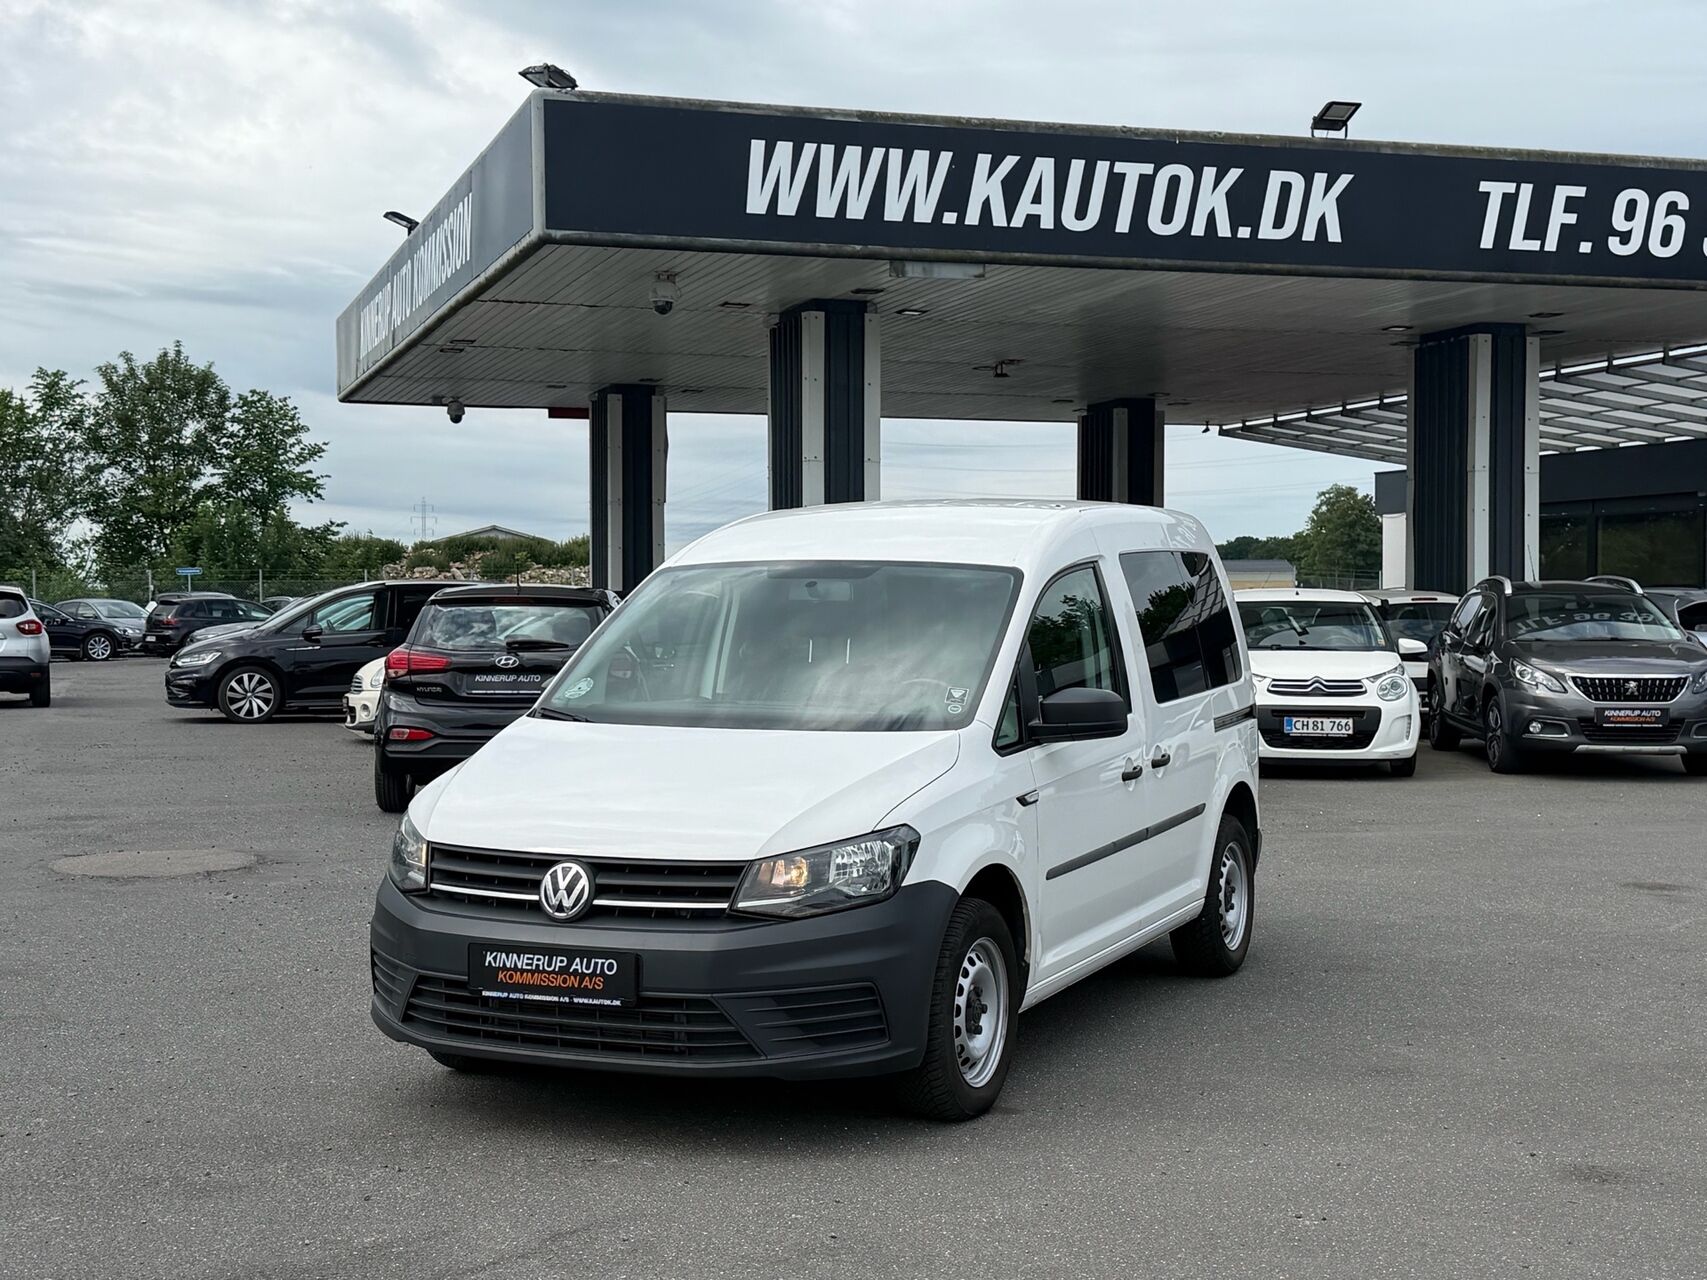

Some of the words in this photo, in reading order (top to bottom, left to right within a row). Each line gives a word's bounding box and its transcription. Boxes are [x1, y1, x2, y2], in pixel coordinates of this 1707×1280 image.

[746, 139, 1354, 243] WWW.KAUTOK.DK
[1478, 180, 1593, 253] TLF.
[1607, 188, 1690, 258] 96
[360, 282, 391, 359] KINNERUP
[391, 258, 412, 331] AUTO
[412, 192, 472, 309] KOMMISSION
[475, 674, 518, 682] KINNERUP
[518, 674, 541, 682] AUTO
[1293, 719, 1310, 731] CH
[1312, 720, 1325, 731] 81
[1329, 720, 1351, 732] 766
[485, 951, 568, 972] KINNERUP
[569, 957, 618, 975] AUTO
[497, 970, 580, 989] KOMMISSION
[581, 976, 605, 990] A/S
